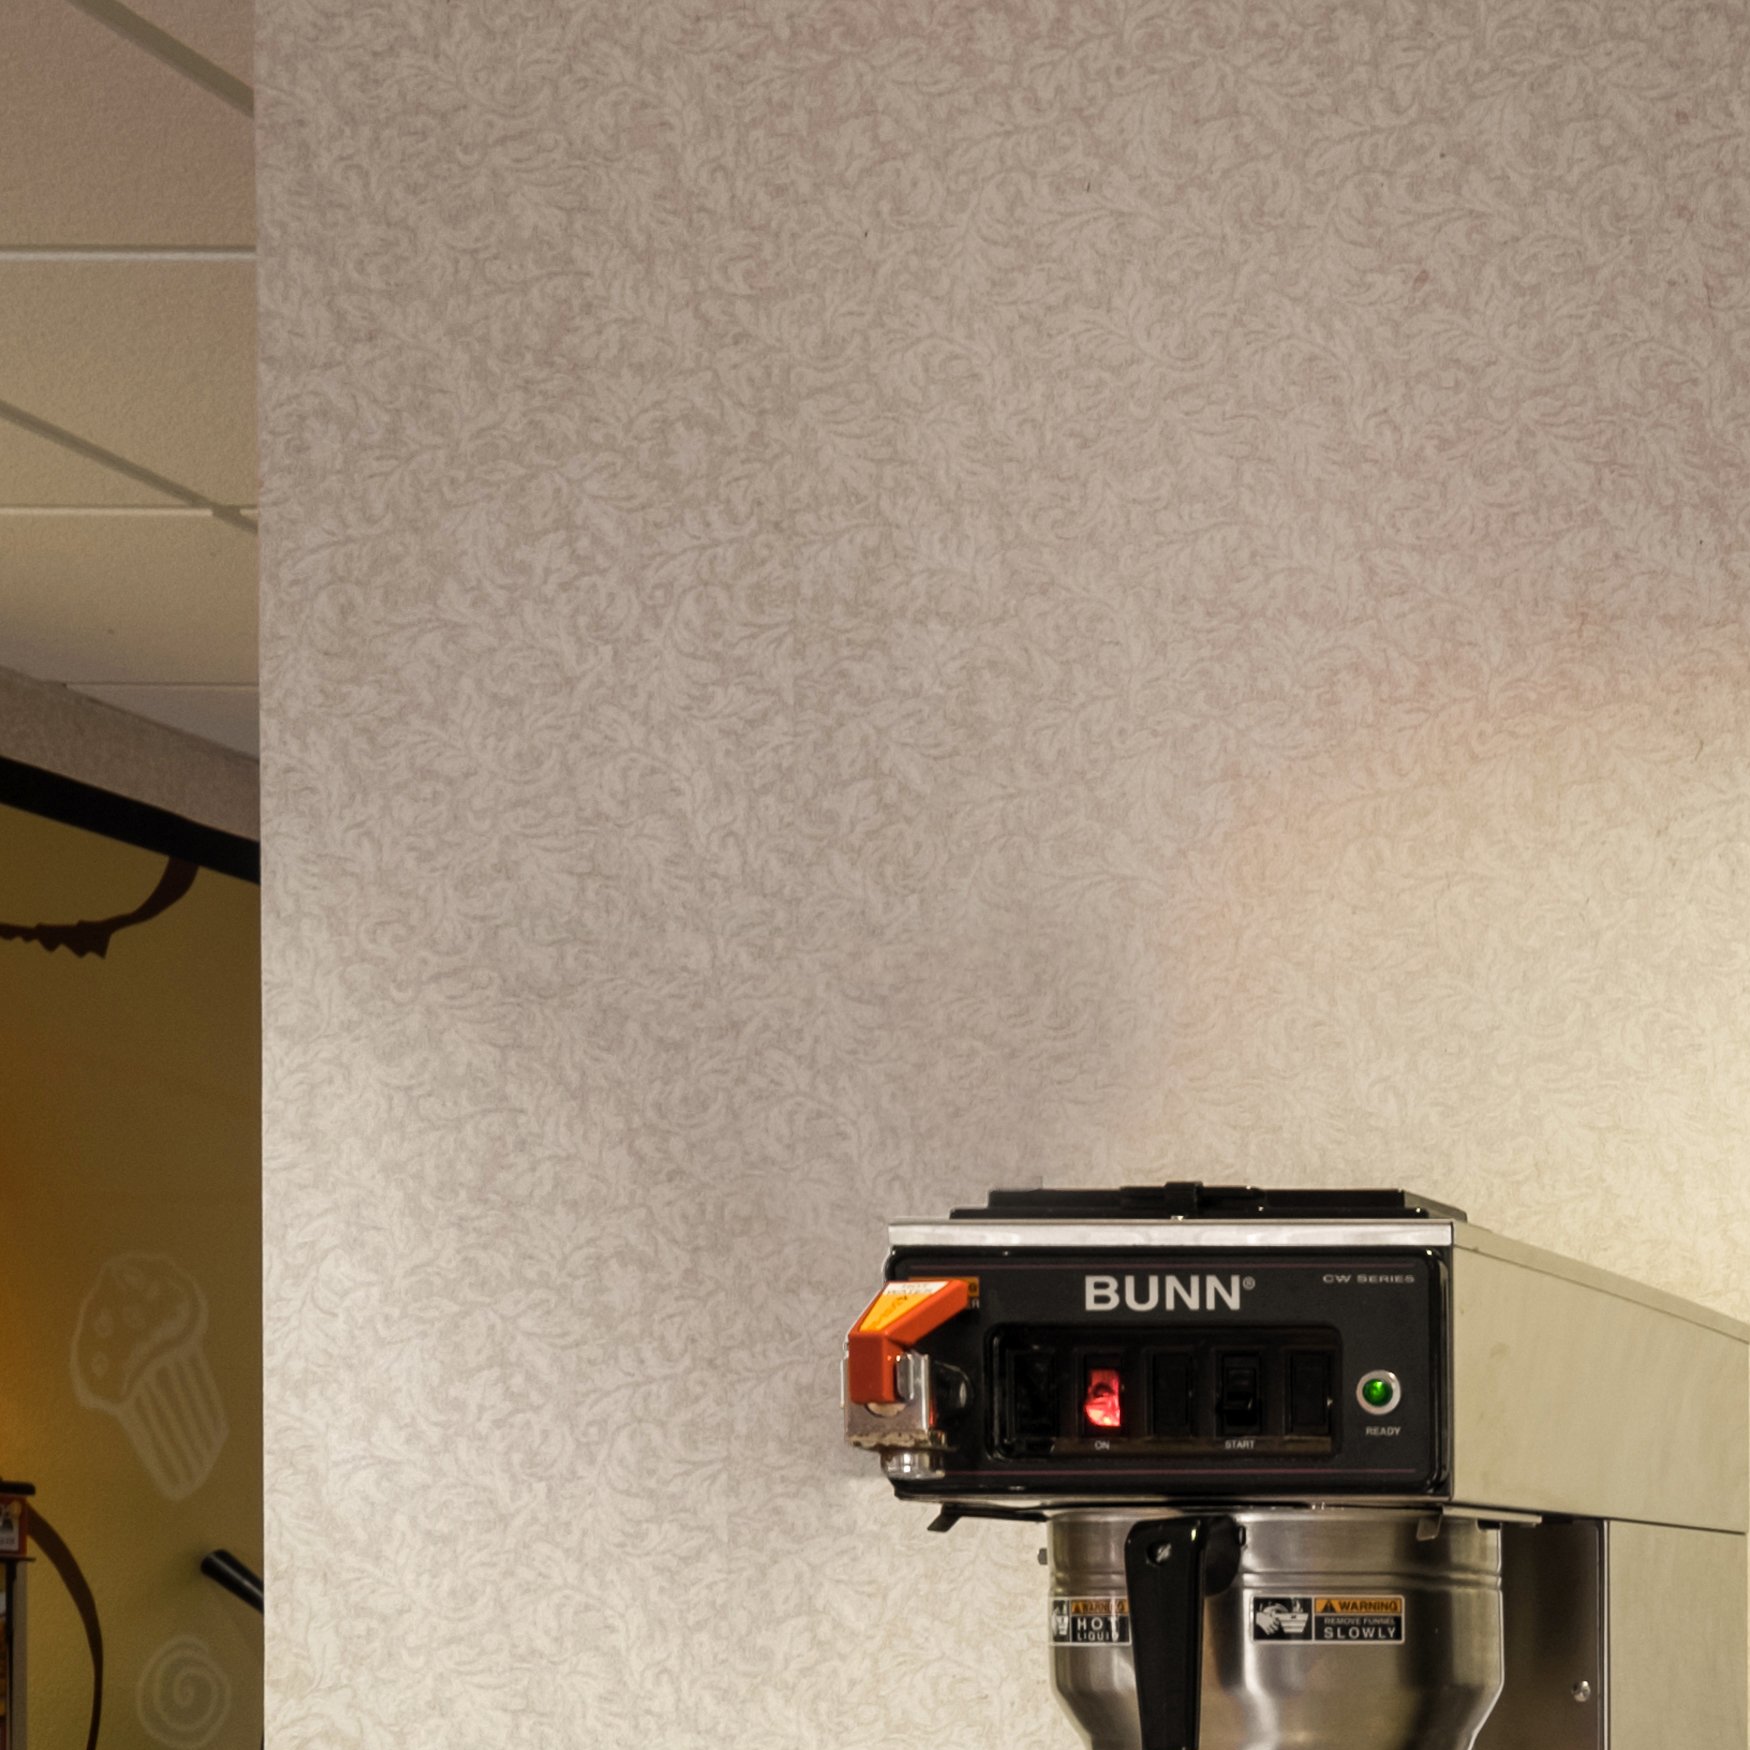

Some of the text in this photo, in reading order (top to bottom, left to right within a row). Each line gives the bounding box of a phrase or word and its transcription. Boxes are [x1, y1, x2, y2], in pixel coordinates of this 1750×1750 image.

[1323, 1274, 1415, 1284] CW SERIES
[1366, 1426, 1402, 1437] READY
[1094, 1440, 1111, 1451] ON
[1225, 1440, 1256, 1450] START
[1338, 1600, 1398, 1612] WARNING
[1077, 1616, 1120, 1631] HOT
[1324, 1626, 1396, 1639] SLOWLY
